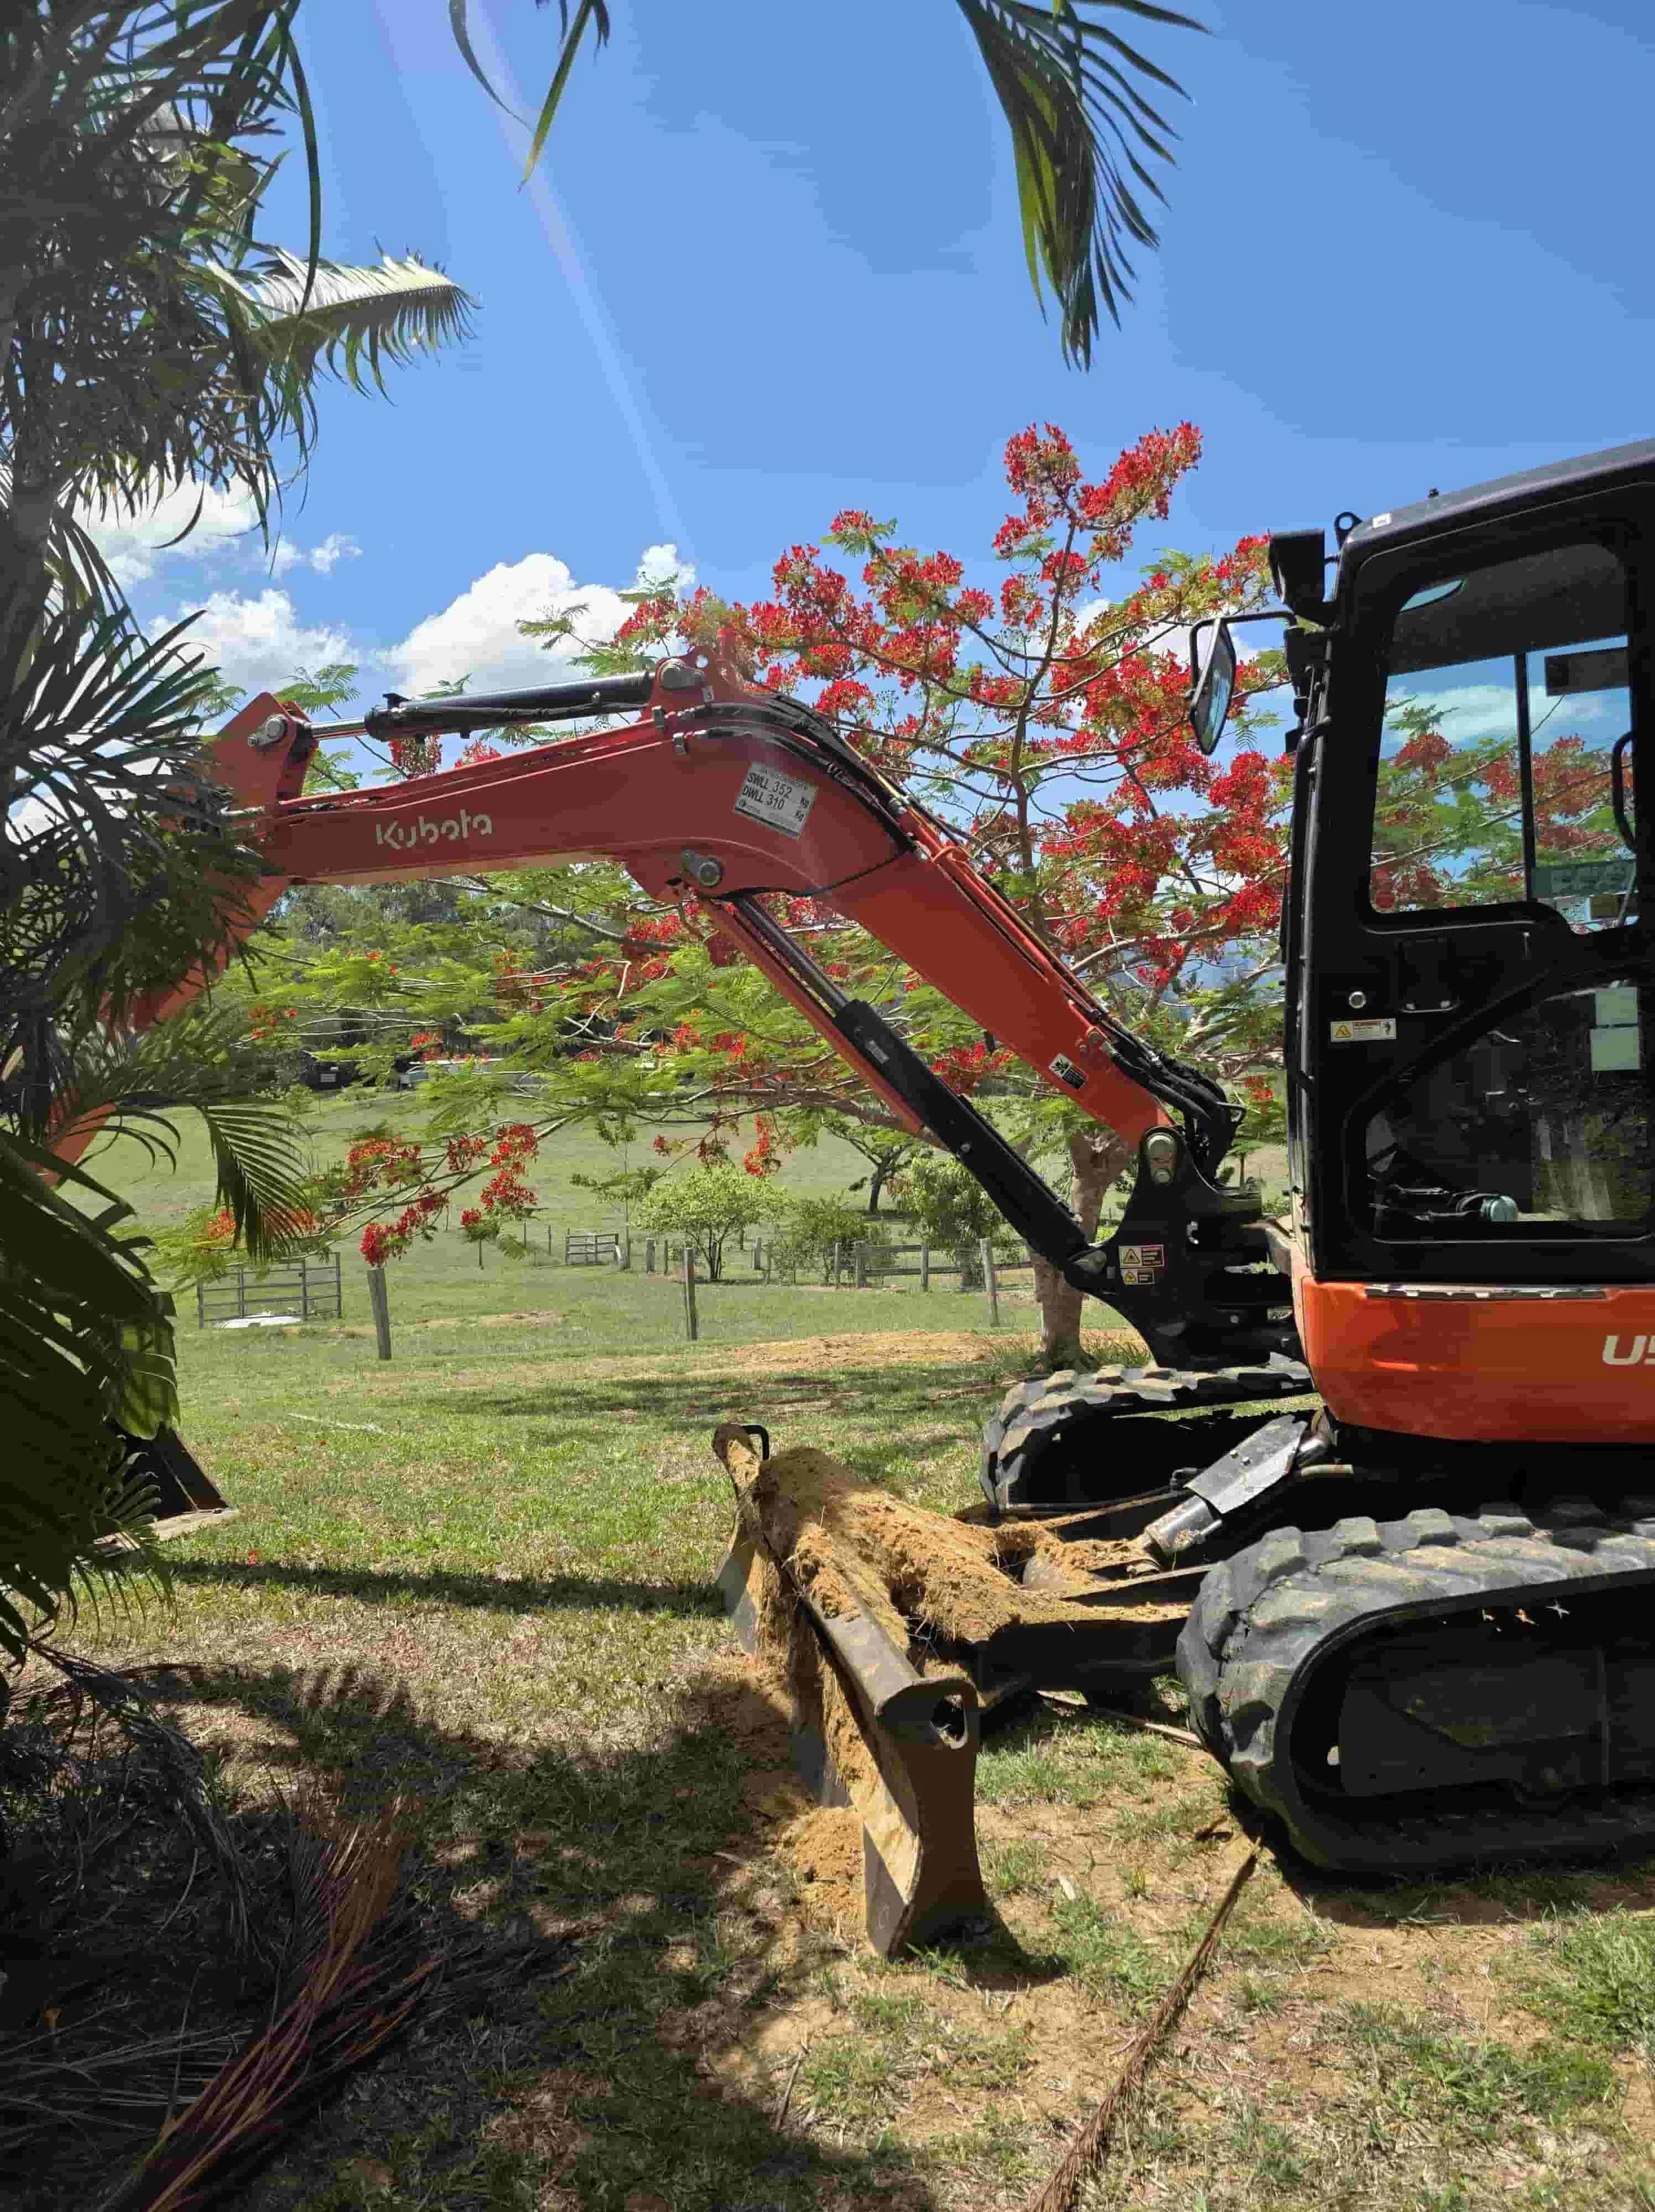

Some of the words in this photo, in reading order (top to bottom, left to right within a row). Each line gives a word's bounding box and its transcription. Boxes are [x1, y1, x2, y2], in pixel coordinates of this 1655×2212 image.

[747, 772, 769, 790] SWLL
[773, 781, 792, 799] 352
[767, 794, 785, 810] 310
[375, 809, 493, 850] Kubota
[1602, 1335, 1655, 1365] U
